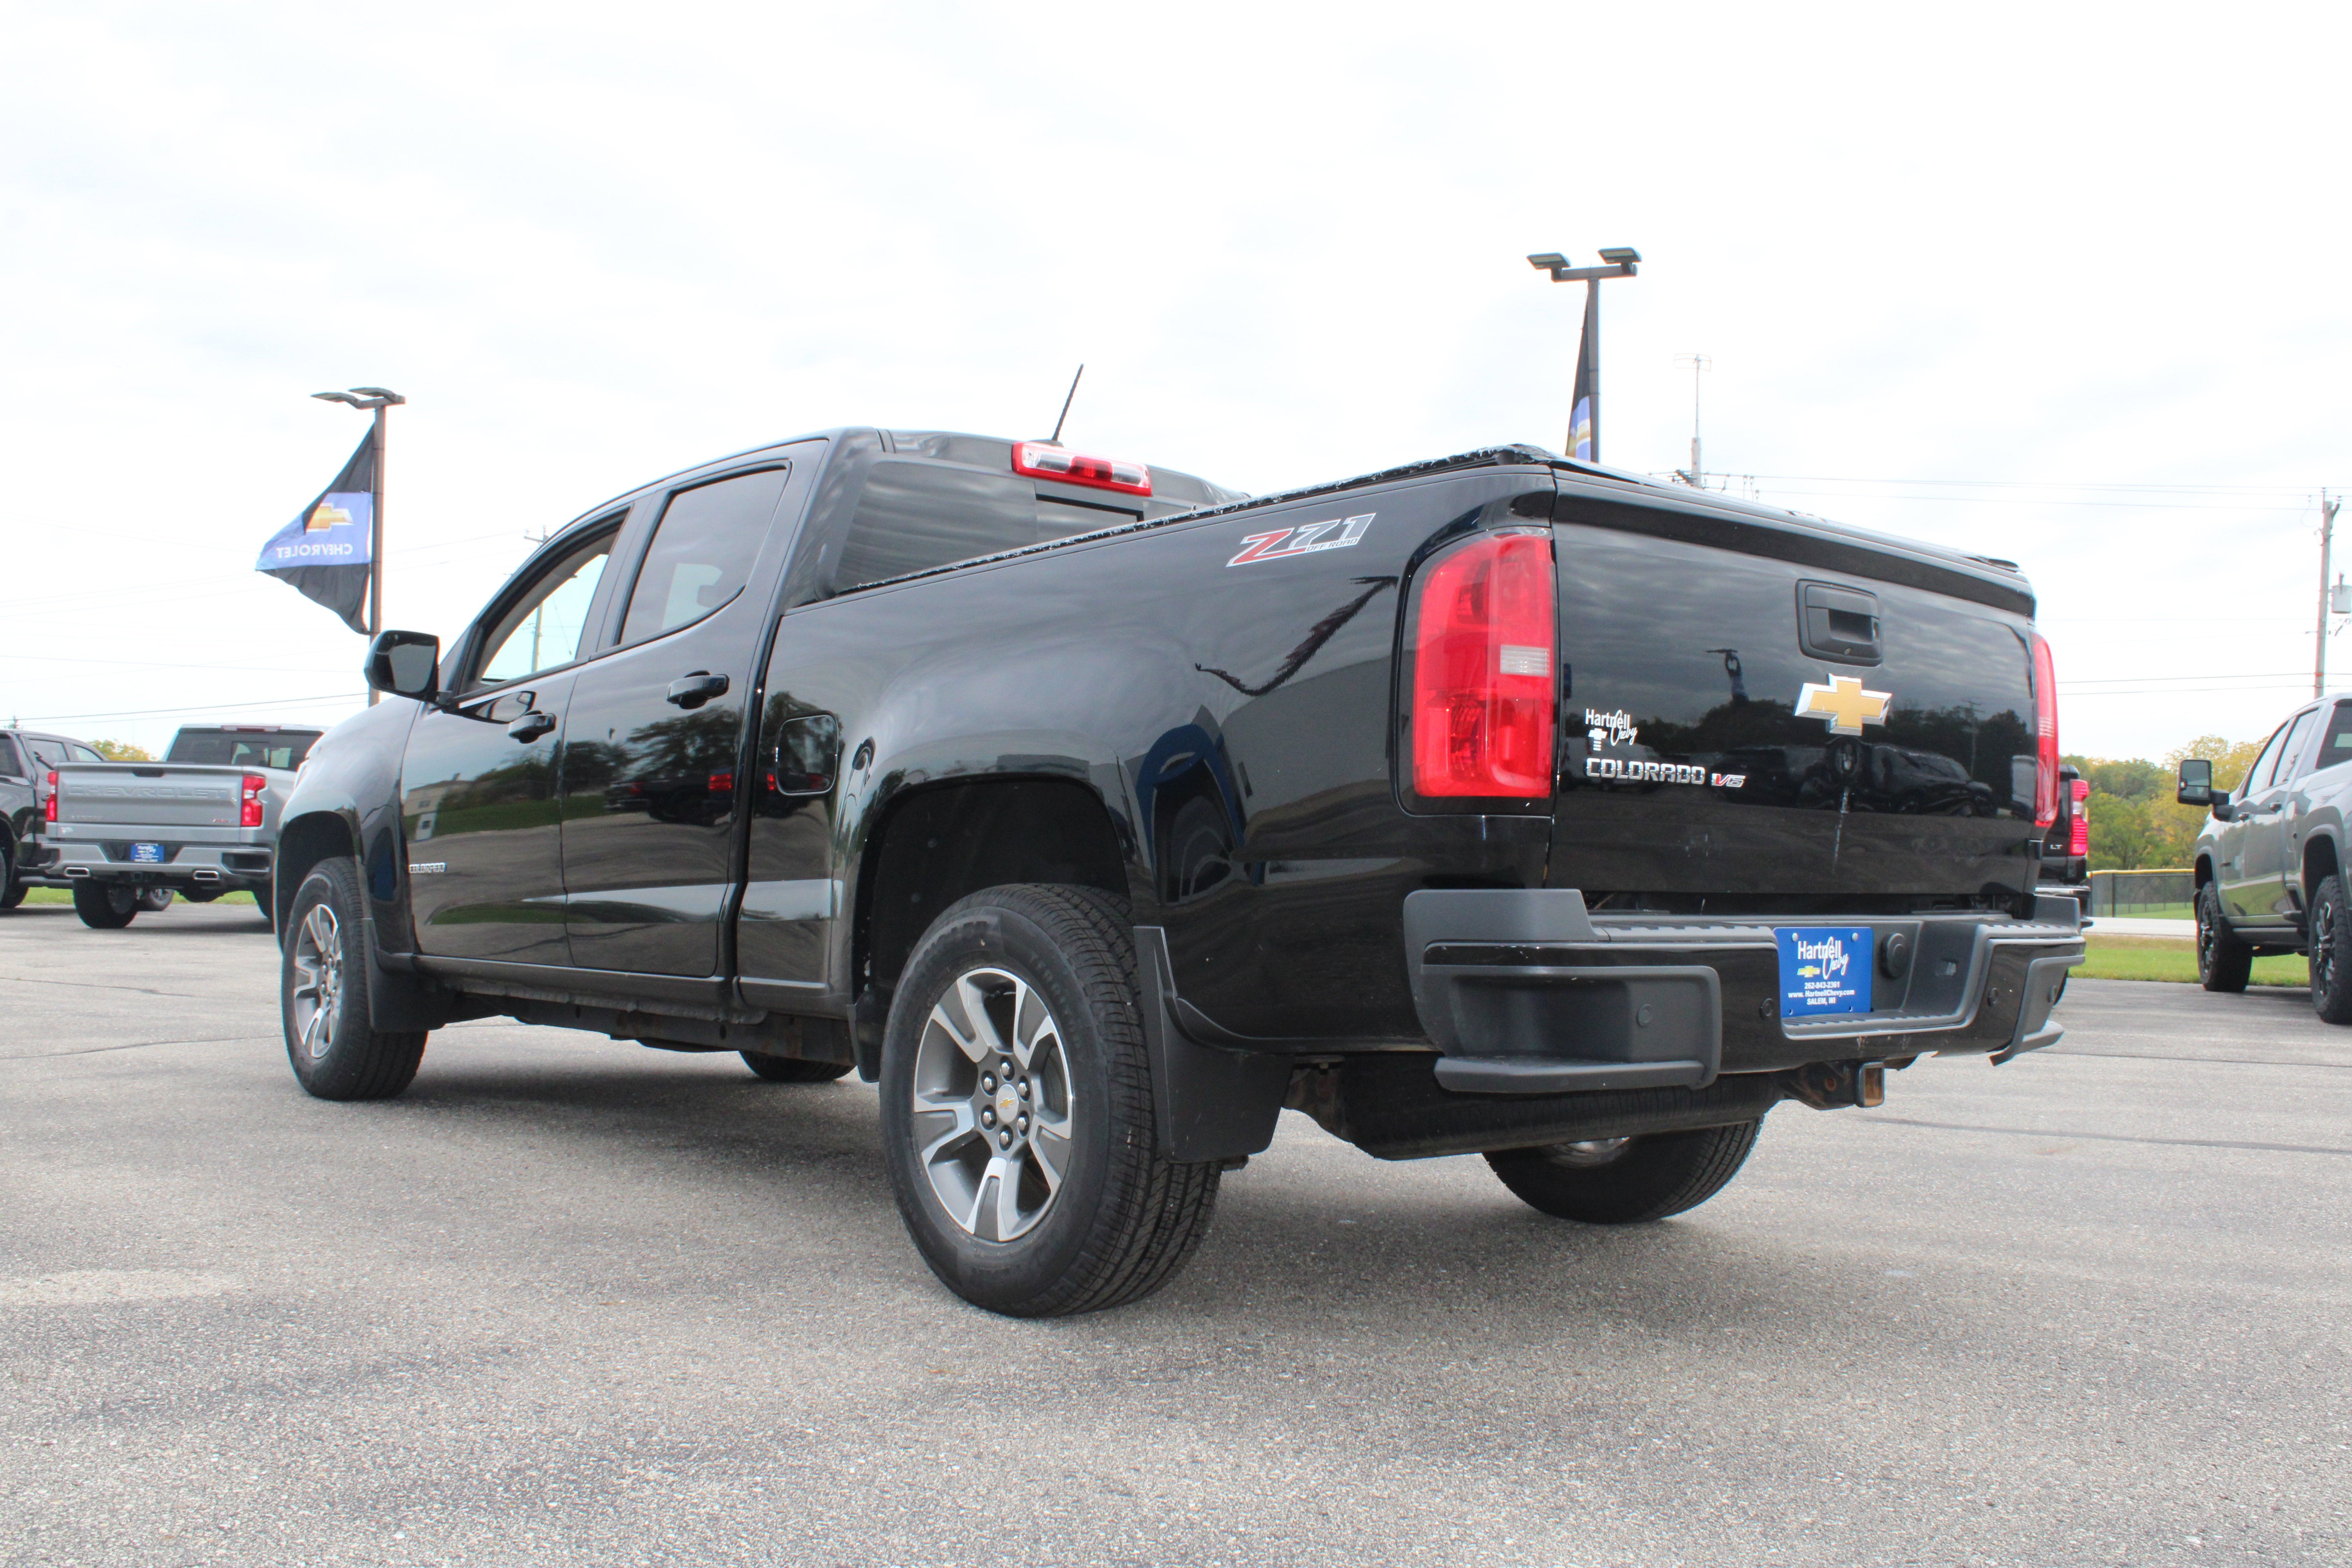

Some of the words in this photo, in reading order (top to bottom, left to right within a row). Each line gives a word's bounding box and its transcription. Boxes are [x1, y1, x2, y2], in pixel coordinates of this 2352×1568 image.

[1226, 512, 1376, 567] Z71
[1306, 543, 1327, 552] OFF
[1328, 538, 1359, 548] ROAD
[1585, 708, 1630, 730] Hartnell
[1610, 709, 1637, 746] Chevy
[1586, 757, 1706, 785] COLORADO
[1711, 773, 1746, 788] V6
[68, 785, 227, 798] CHEVROLET
[409, 862, 446, 873] COLORADO
[1797, 940, 1842, 960] Hartnell
[1822, 936, 1849, 980] Chevy
[1804, 981, 1840, 989] 262-843-2361
[1806, 997, 1828, 1005] SALEM,
